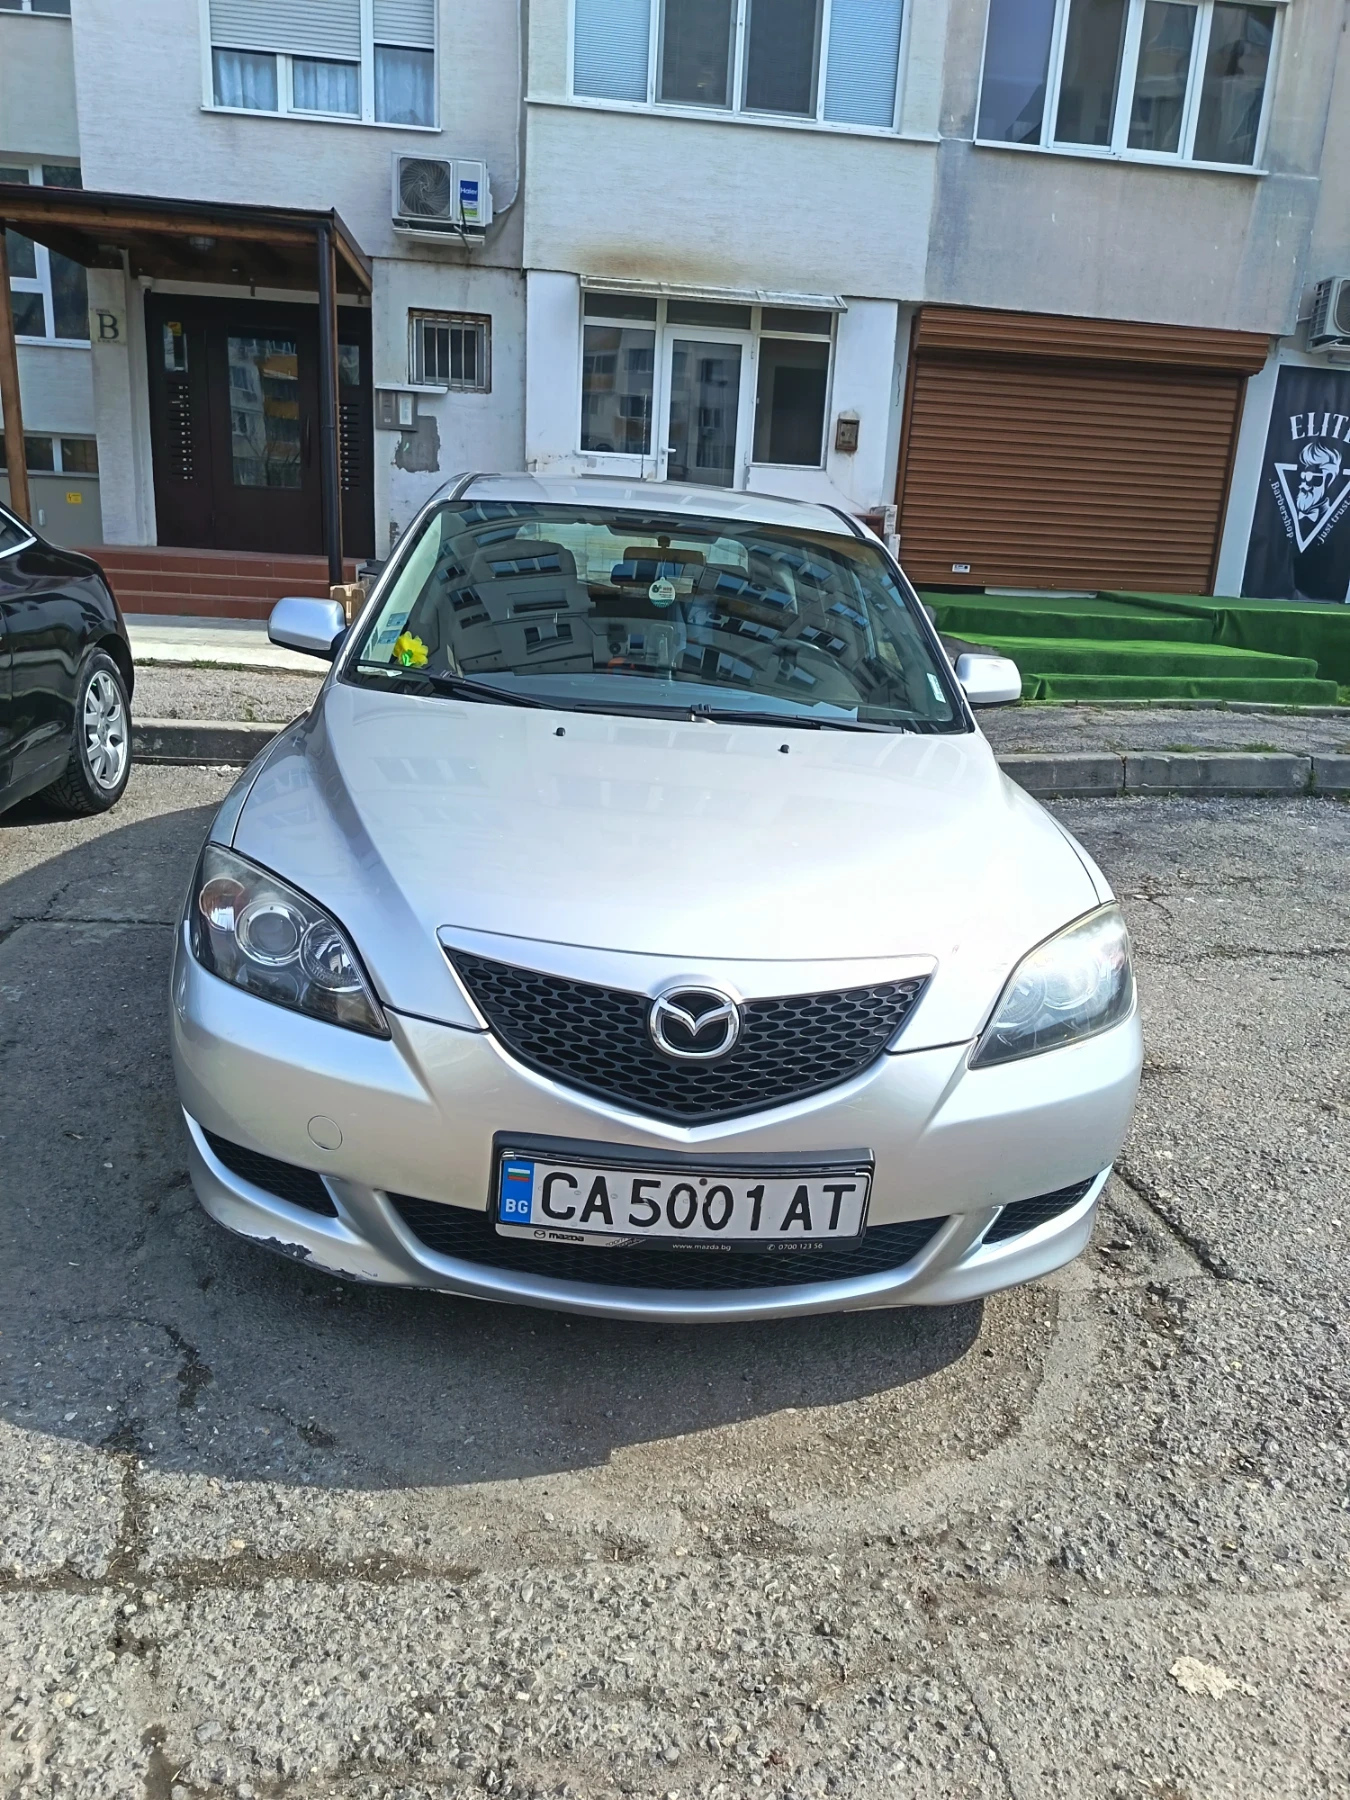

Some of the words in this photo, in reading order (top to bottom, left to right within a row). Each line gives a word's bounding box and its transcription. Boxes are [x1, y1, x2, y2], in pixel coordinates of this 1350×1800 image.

[1271, 481, 1294, 539] Barbershop
[1317, 523, 1334, 544] just
[505, 1198, 529, 1214] BG
[541, 1171, 613, 1225] CA
[628, 1178, 765, 1231] 5001
[779, 1184, 857, 1231] AT
[672, 1242, 732, 1253] www.mazda.bg
